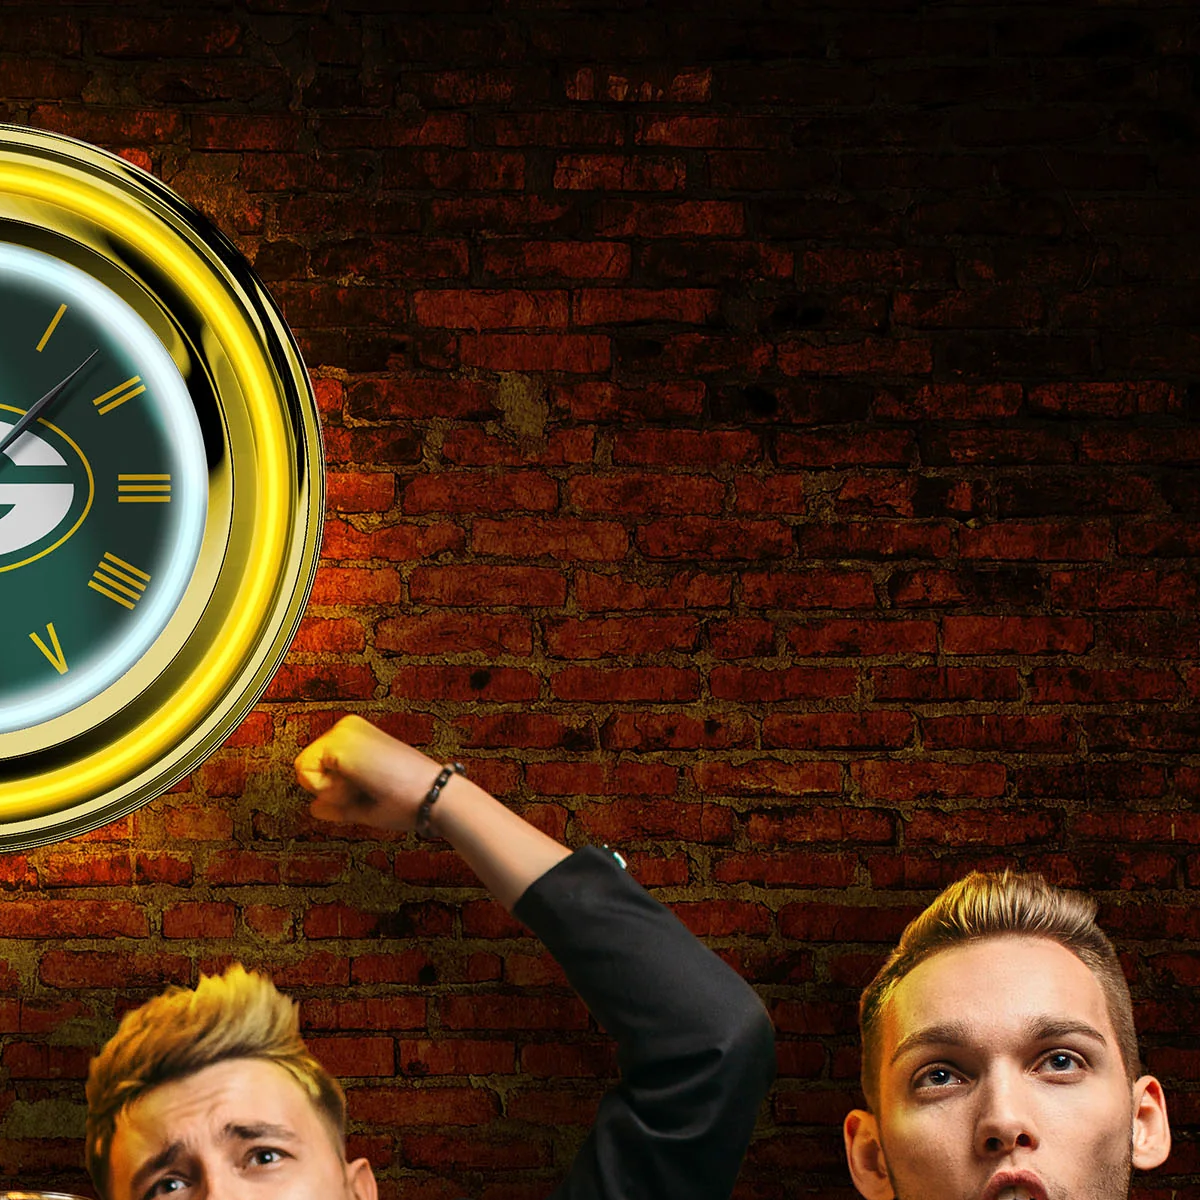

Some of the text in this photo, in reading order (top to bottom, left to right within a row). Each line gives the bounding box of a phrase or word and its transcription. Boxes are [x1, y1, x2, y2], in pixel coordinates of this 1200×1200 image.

[36, 304, 67, 352] I
[92, 376, 147, 416] II
[117, 473, 171, 503] III
[87, 551, 151, 610] IIII
[29, 622, 69, 675] V
